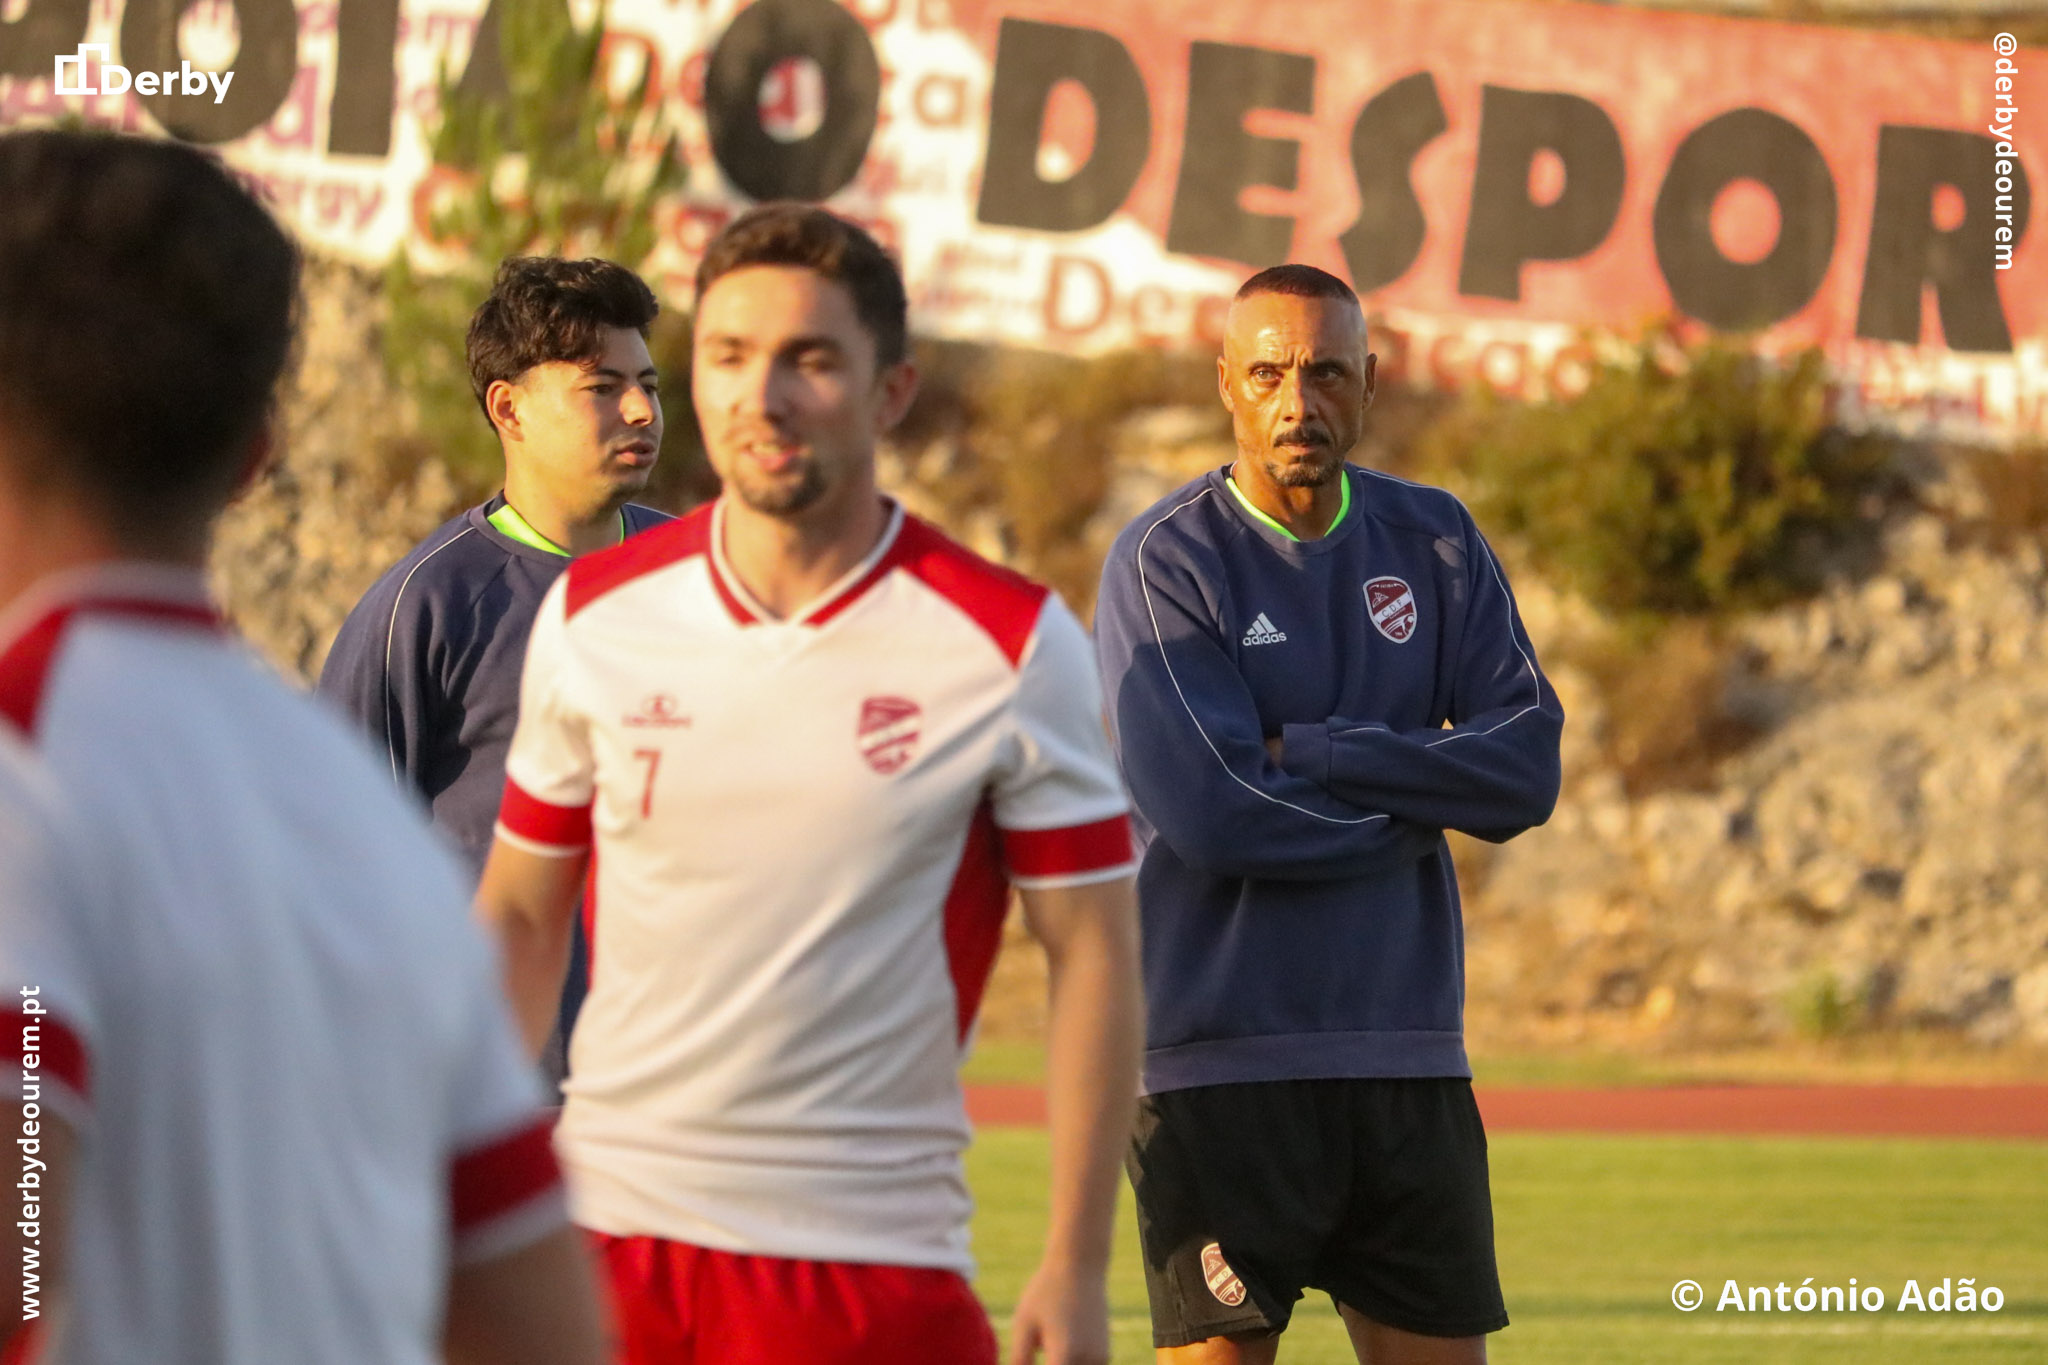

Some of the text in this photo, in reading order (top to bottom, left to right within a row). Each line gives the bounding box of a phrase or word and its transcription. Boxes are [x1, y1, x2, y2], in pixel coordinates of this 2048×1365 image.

[705, 0, 881, 204] O
[977, 17, 2031, 353] DESPOR
[1242, 630, 1288, 647] adidas
[633, 748, 662, 820] 7
